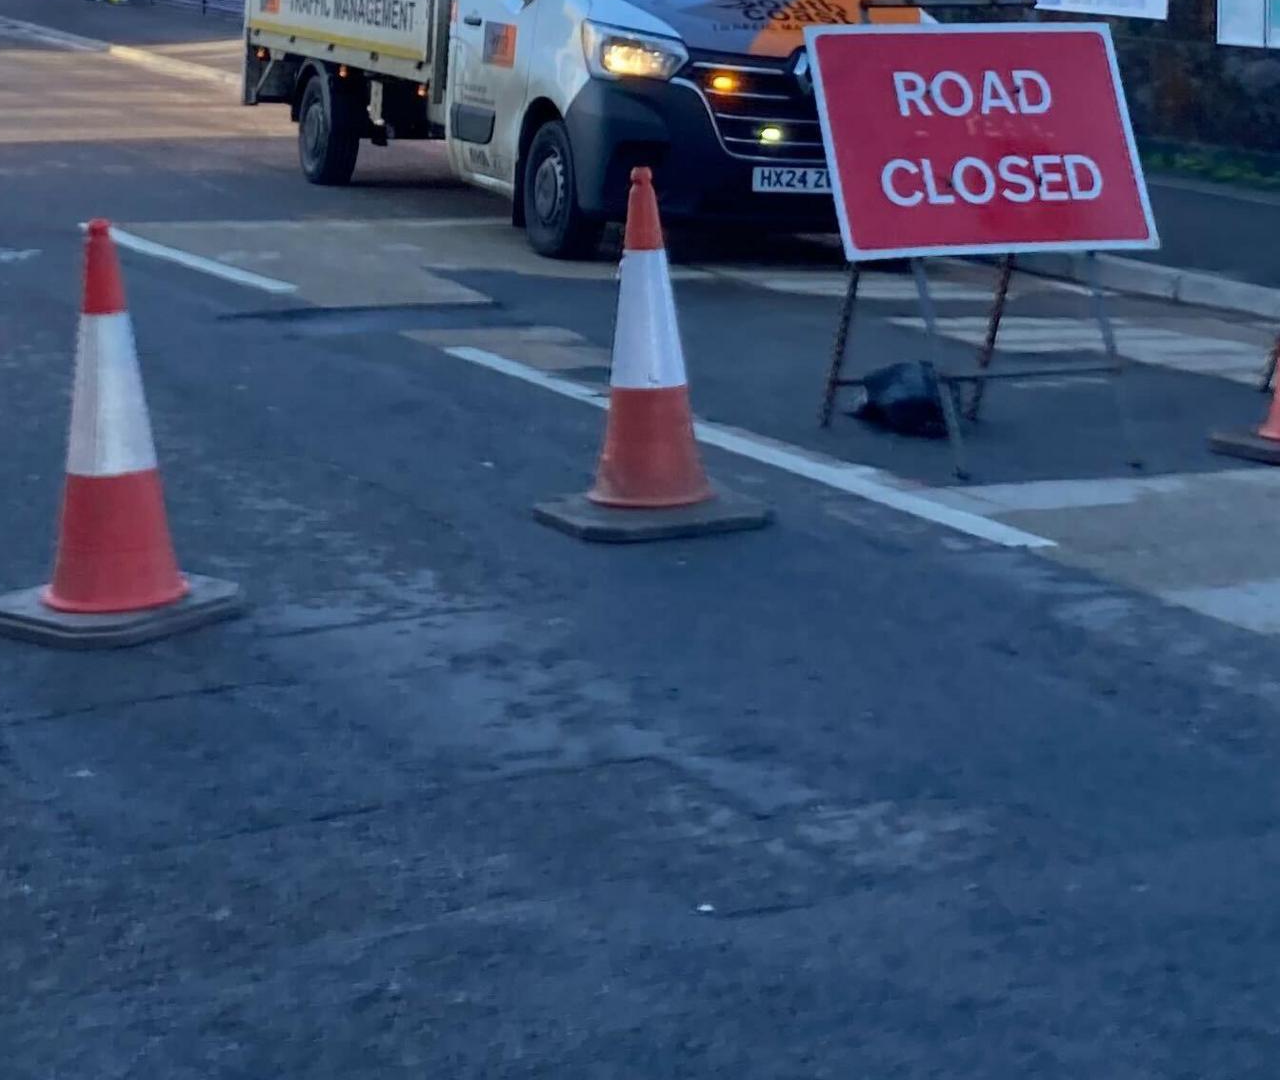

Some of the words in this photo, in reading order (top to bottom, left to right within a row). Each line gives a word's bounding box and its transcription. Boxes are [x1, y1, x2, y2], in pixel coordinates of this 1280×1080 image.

[893, 69, 1052, 117] ROAD
[760, 170, 807, 188] HX24
[881, 154, 1103, 207] CLOSED
